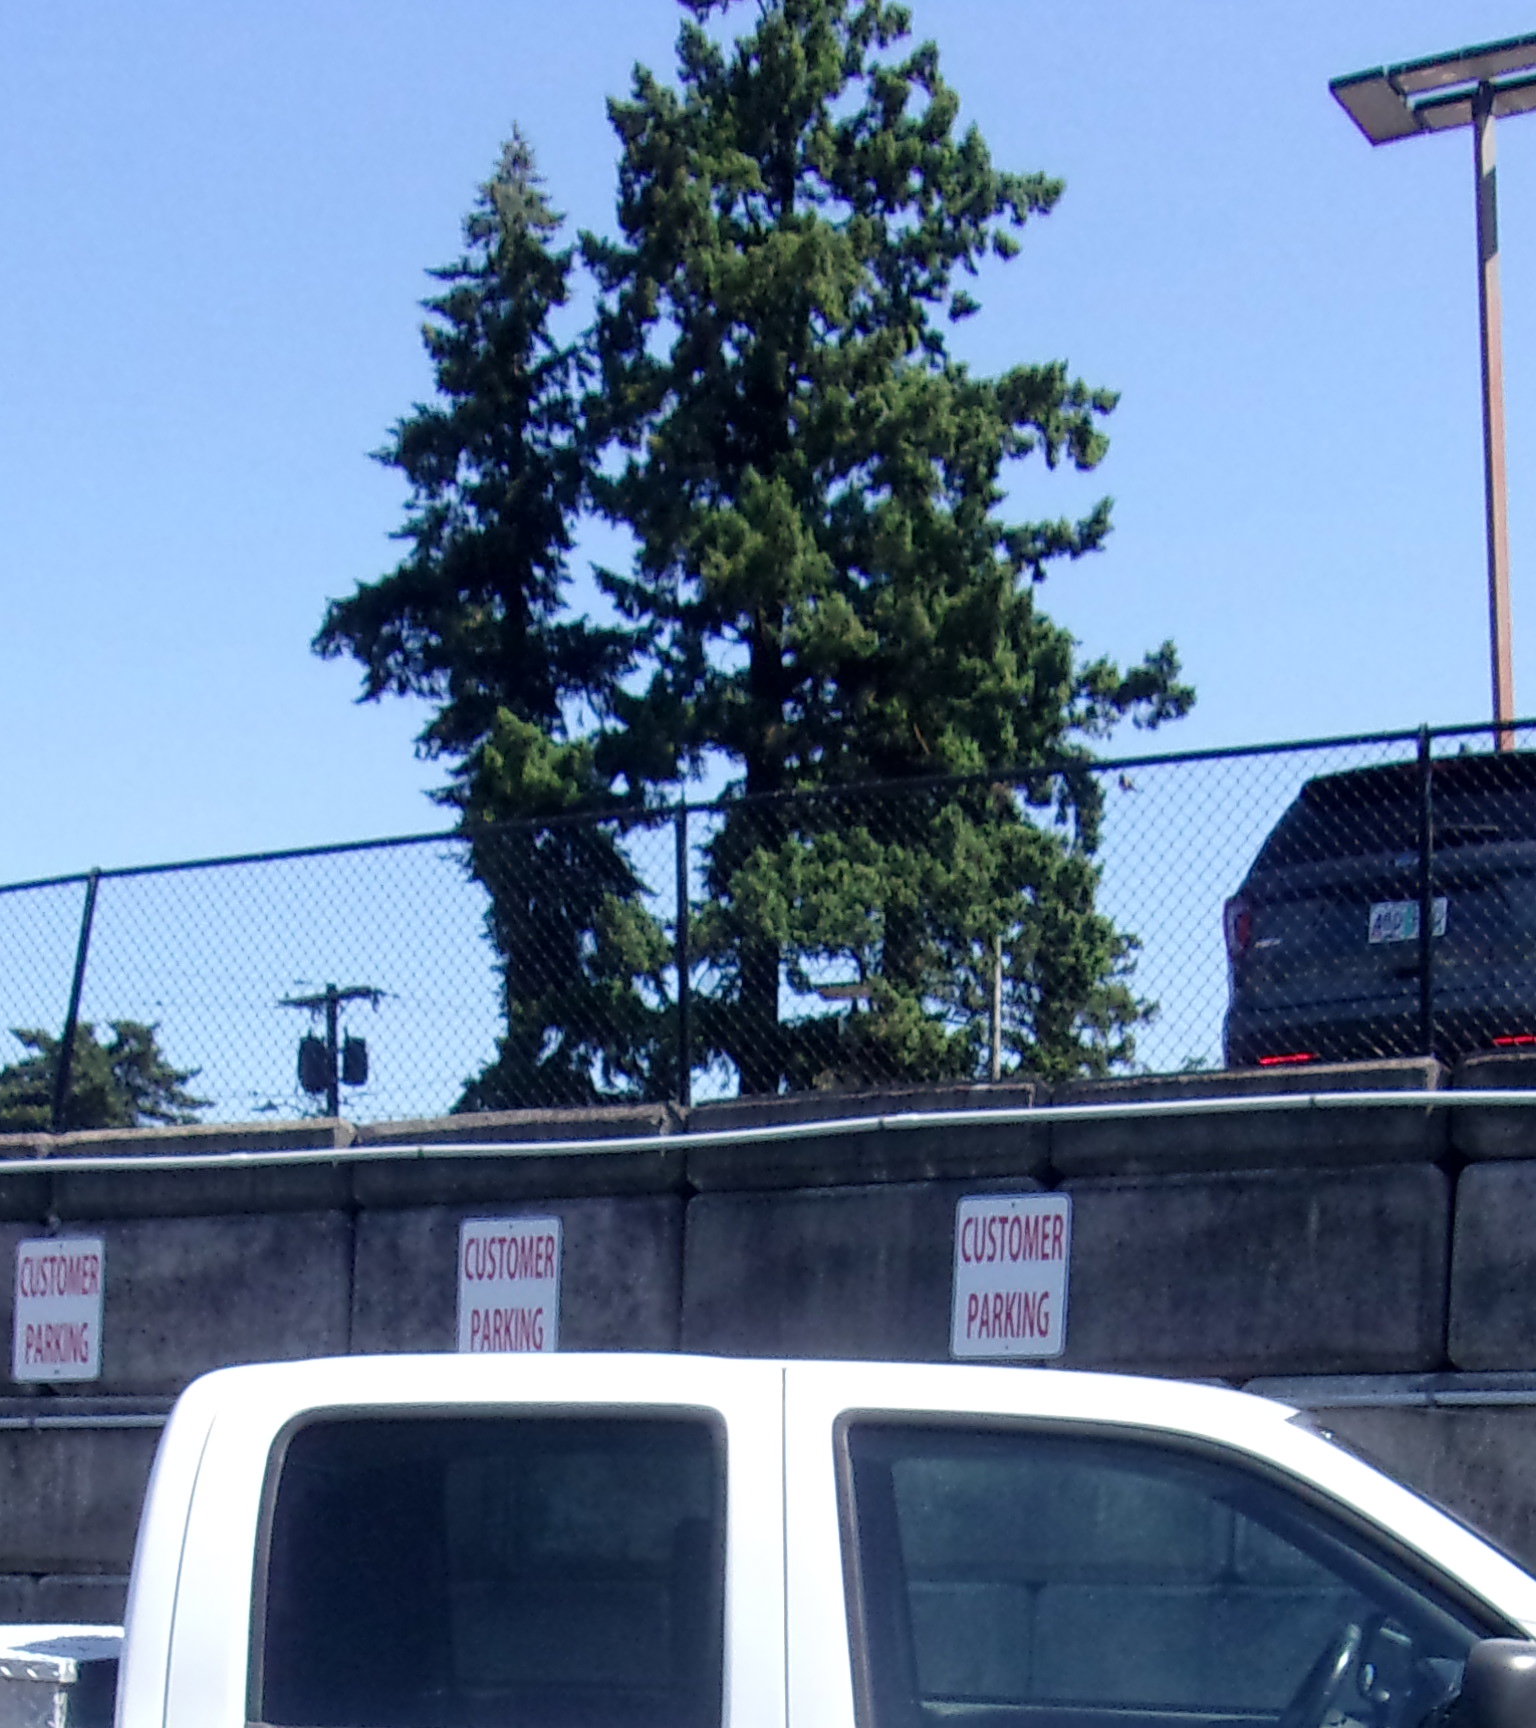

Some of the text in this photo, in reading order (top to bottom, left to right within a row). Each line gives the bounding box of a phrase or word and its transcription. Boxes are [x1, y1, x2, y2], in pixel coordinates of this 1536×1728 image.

[464, 1235, 555, 1281] CUSTOMER
[961, 1214, 1064, 1263] CUSTOMER
[20, 1255, 99, 1297] CUSTOMER
[470, 1307, 544, 1352] PARKING
[966, 1290, 1051, 1339] PARKING
[25, 1322, 89, 1364] PARKING
